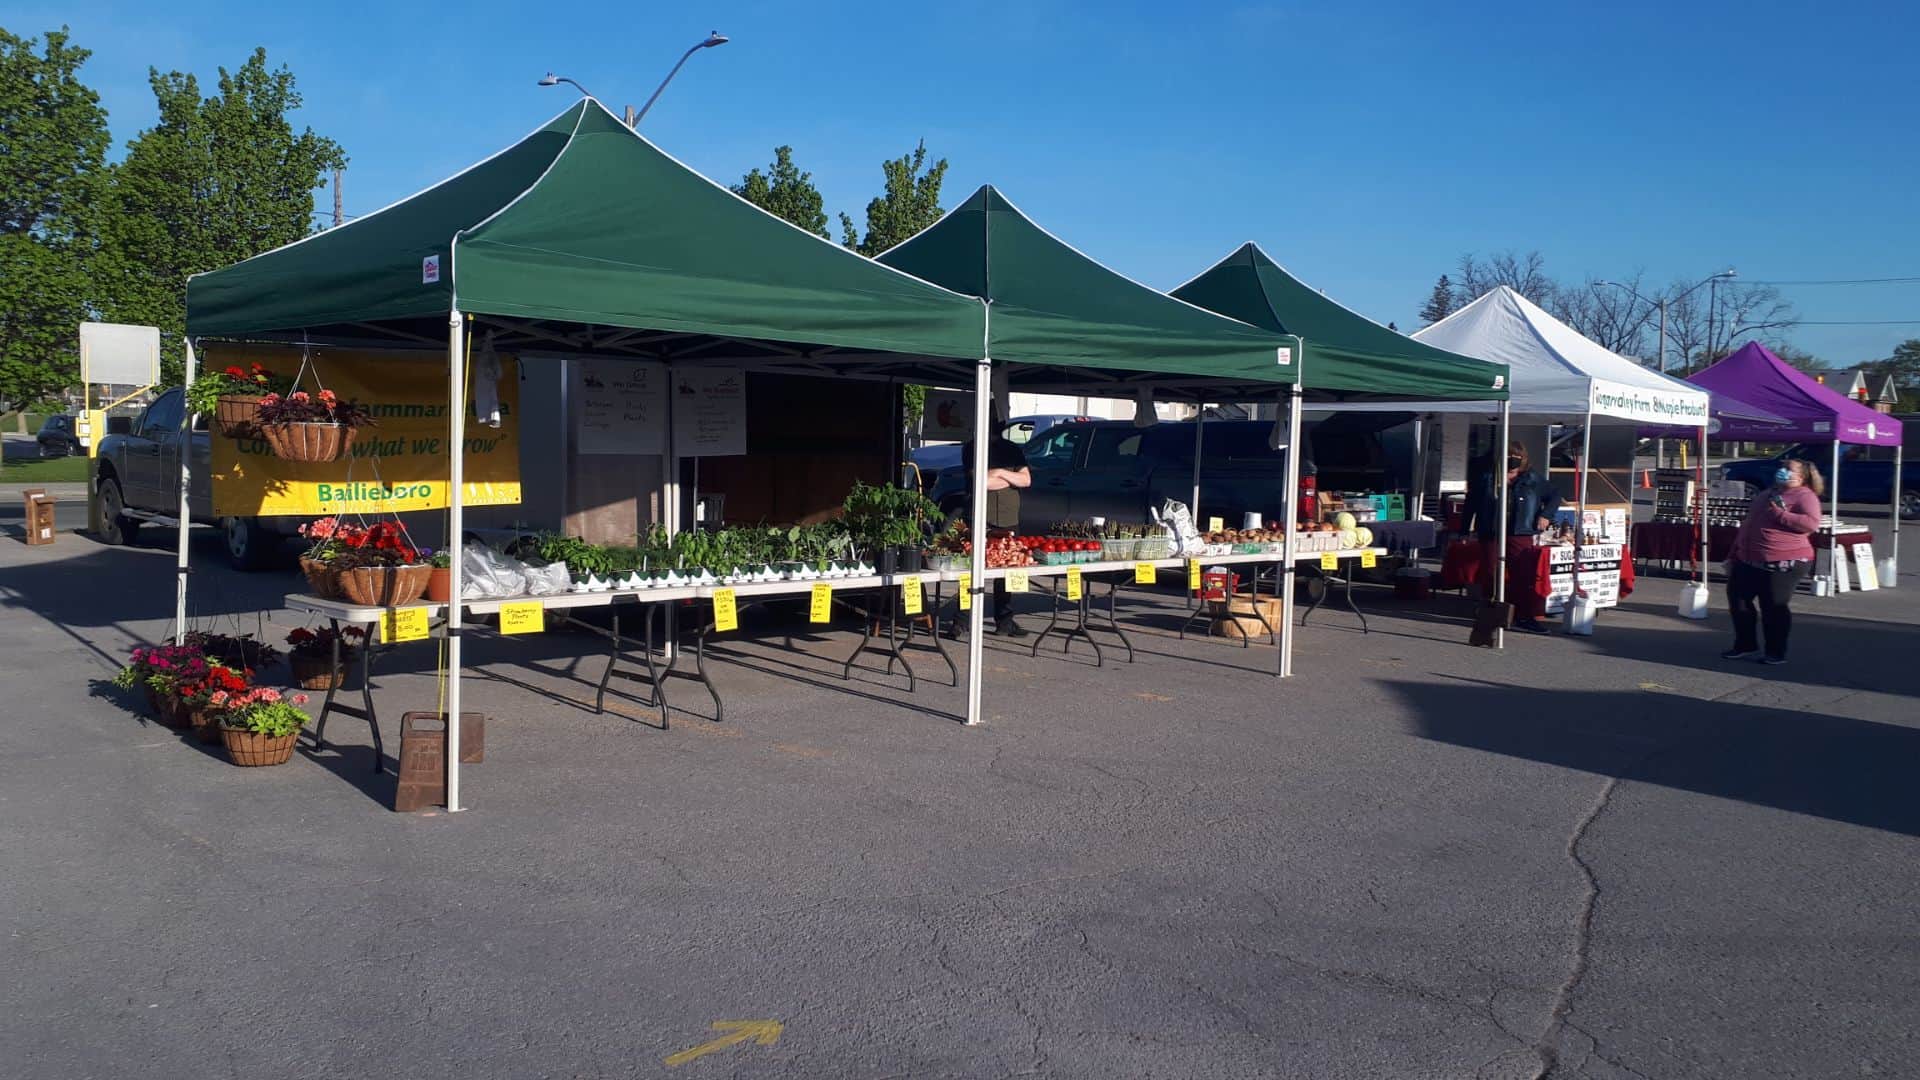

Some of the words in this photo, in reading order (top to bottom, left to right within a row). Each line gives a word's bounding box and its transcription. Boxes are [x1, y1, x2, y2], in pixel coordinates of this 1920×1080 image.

[351, 435, 405, 458] what
[412, 436, 440, 455] we
[318, 482, 431, 502] Bailieboro
